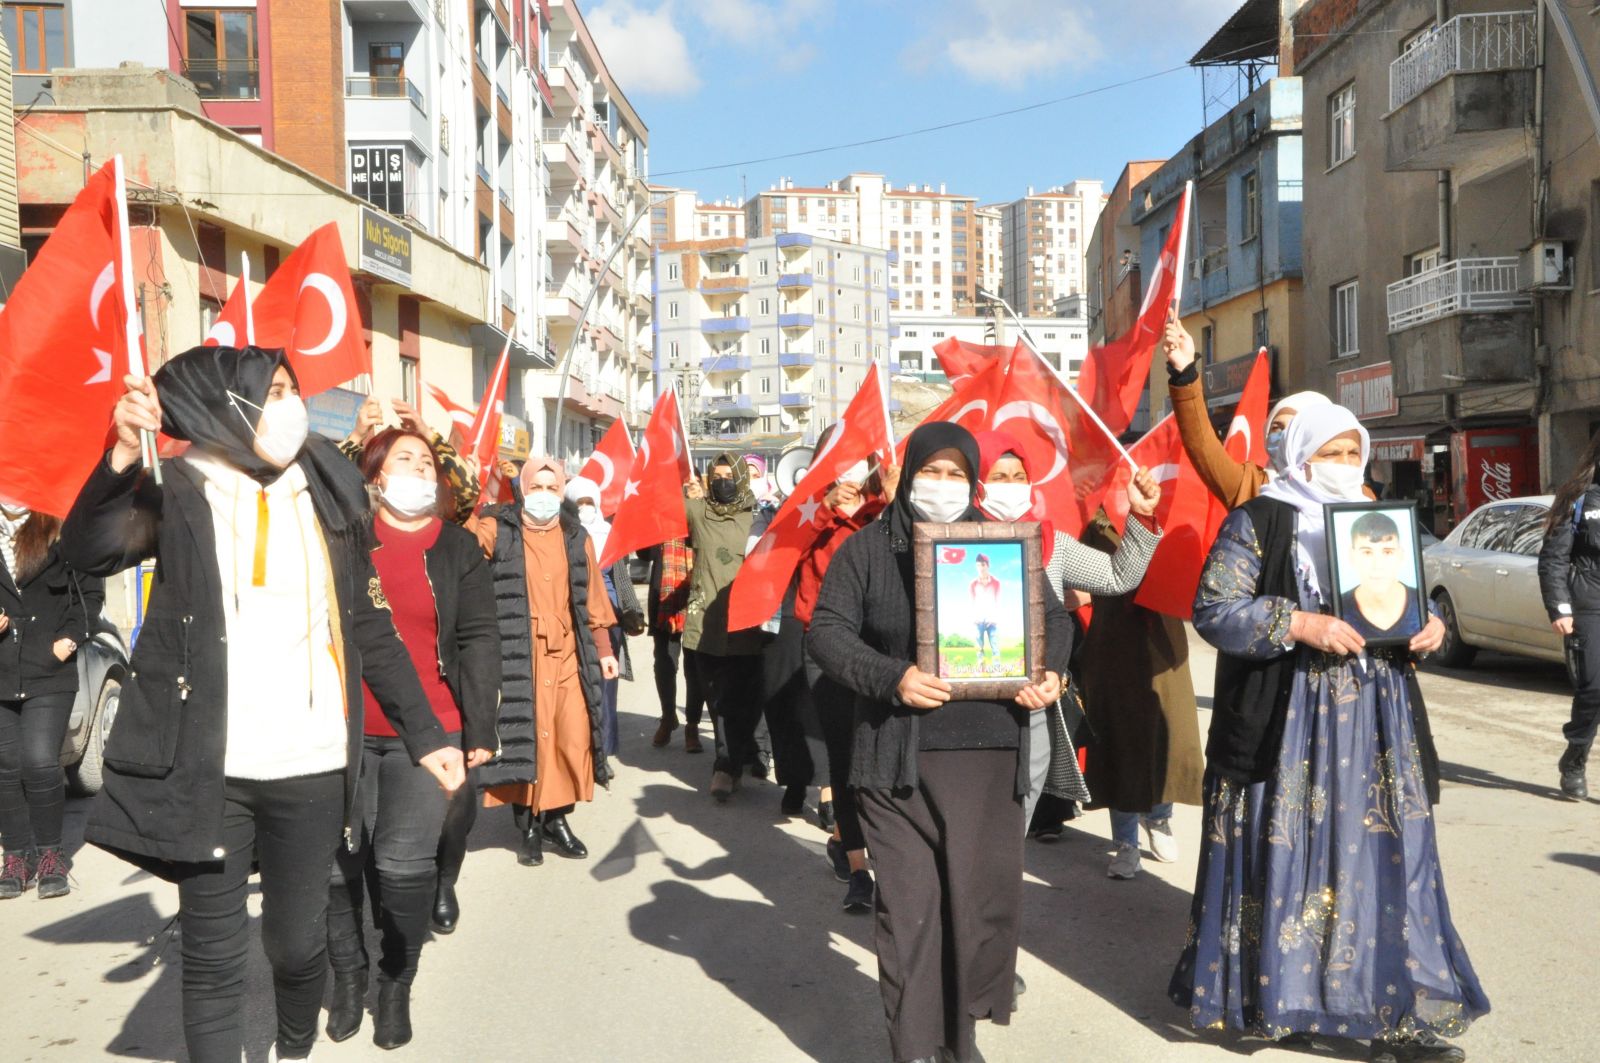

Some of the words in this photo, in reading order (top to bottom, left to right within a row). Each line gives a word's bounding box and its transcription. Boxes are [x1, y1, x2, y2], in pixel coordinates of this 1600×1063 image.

[354, 151, 401, 171] DİŞ
[365, 218, 382, 246] Nuh
[383, 226, 410, 257] Sigorta
[1376, 445, 1414, 460] MARKET
